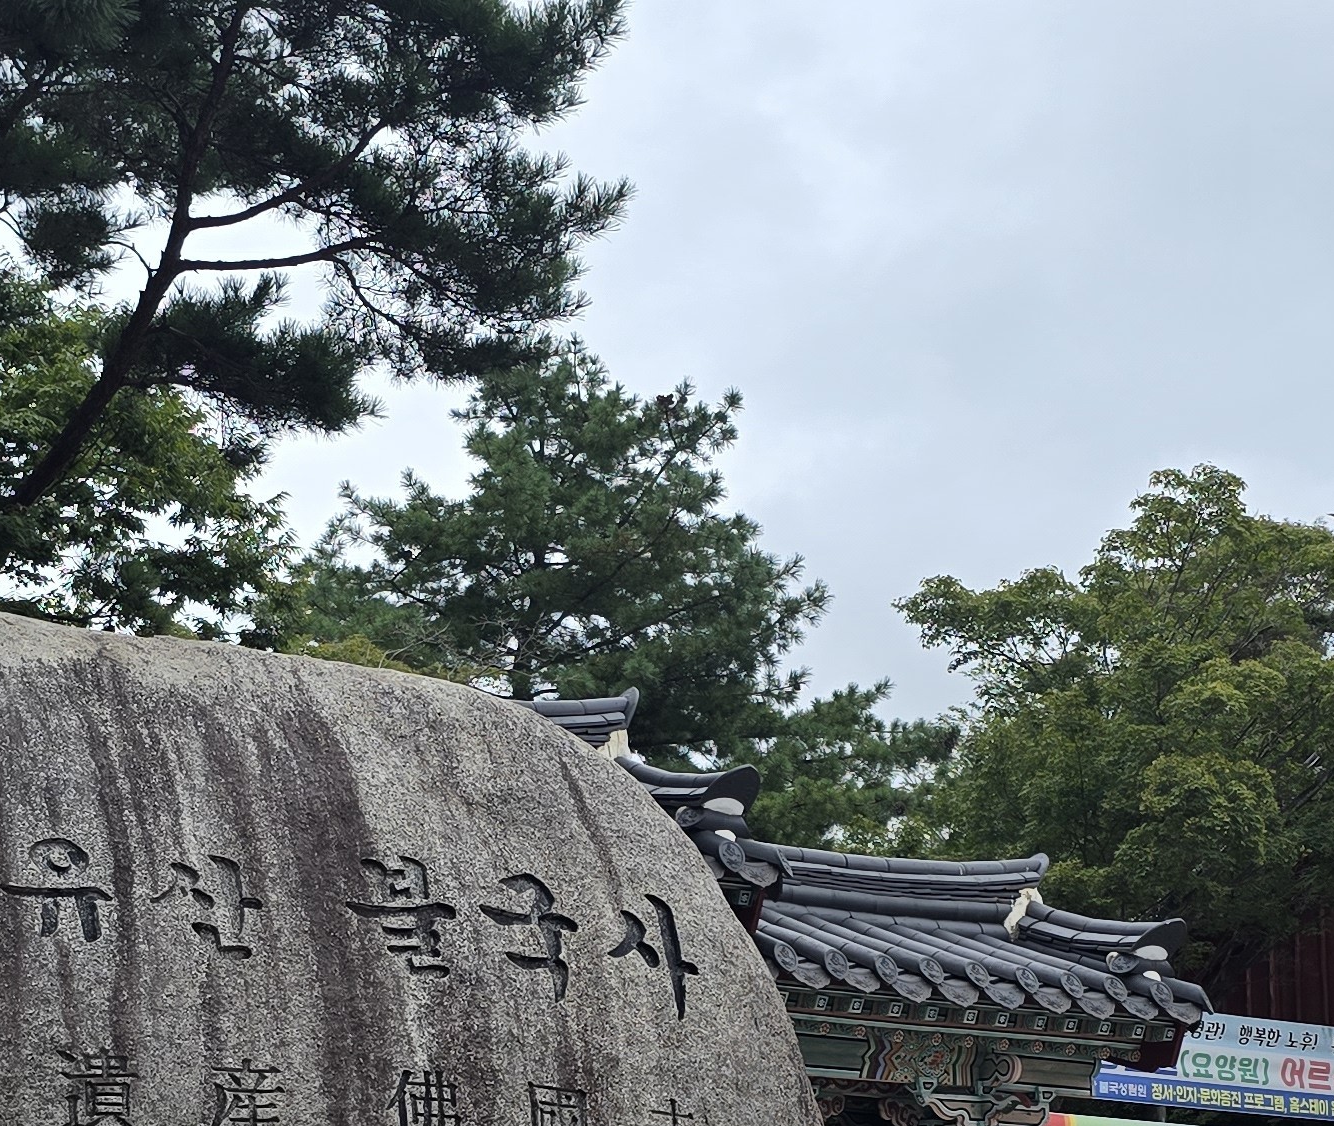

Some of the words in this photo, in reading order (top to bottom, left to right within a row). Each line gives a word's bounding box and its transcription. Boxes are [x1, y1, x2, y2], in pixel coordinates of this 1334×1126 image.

[346, 855, 700, 1020] 불국사
[1238, 1024, 1282, 1048] 행복한
[1284, 1031, 1319, 1051] 노후!
[1099, 1081, 1147, 1098] 국성림원
[1243, 1092, 1287, 1114] 프로그램,
[1289, 1096, 1329, 1117] 홈스테이
